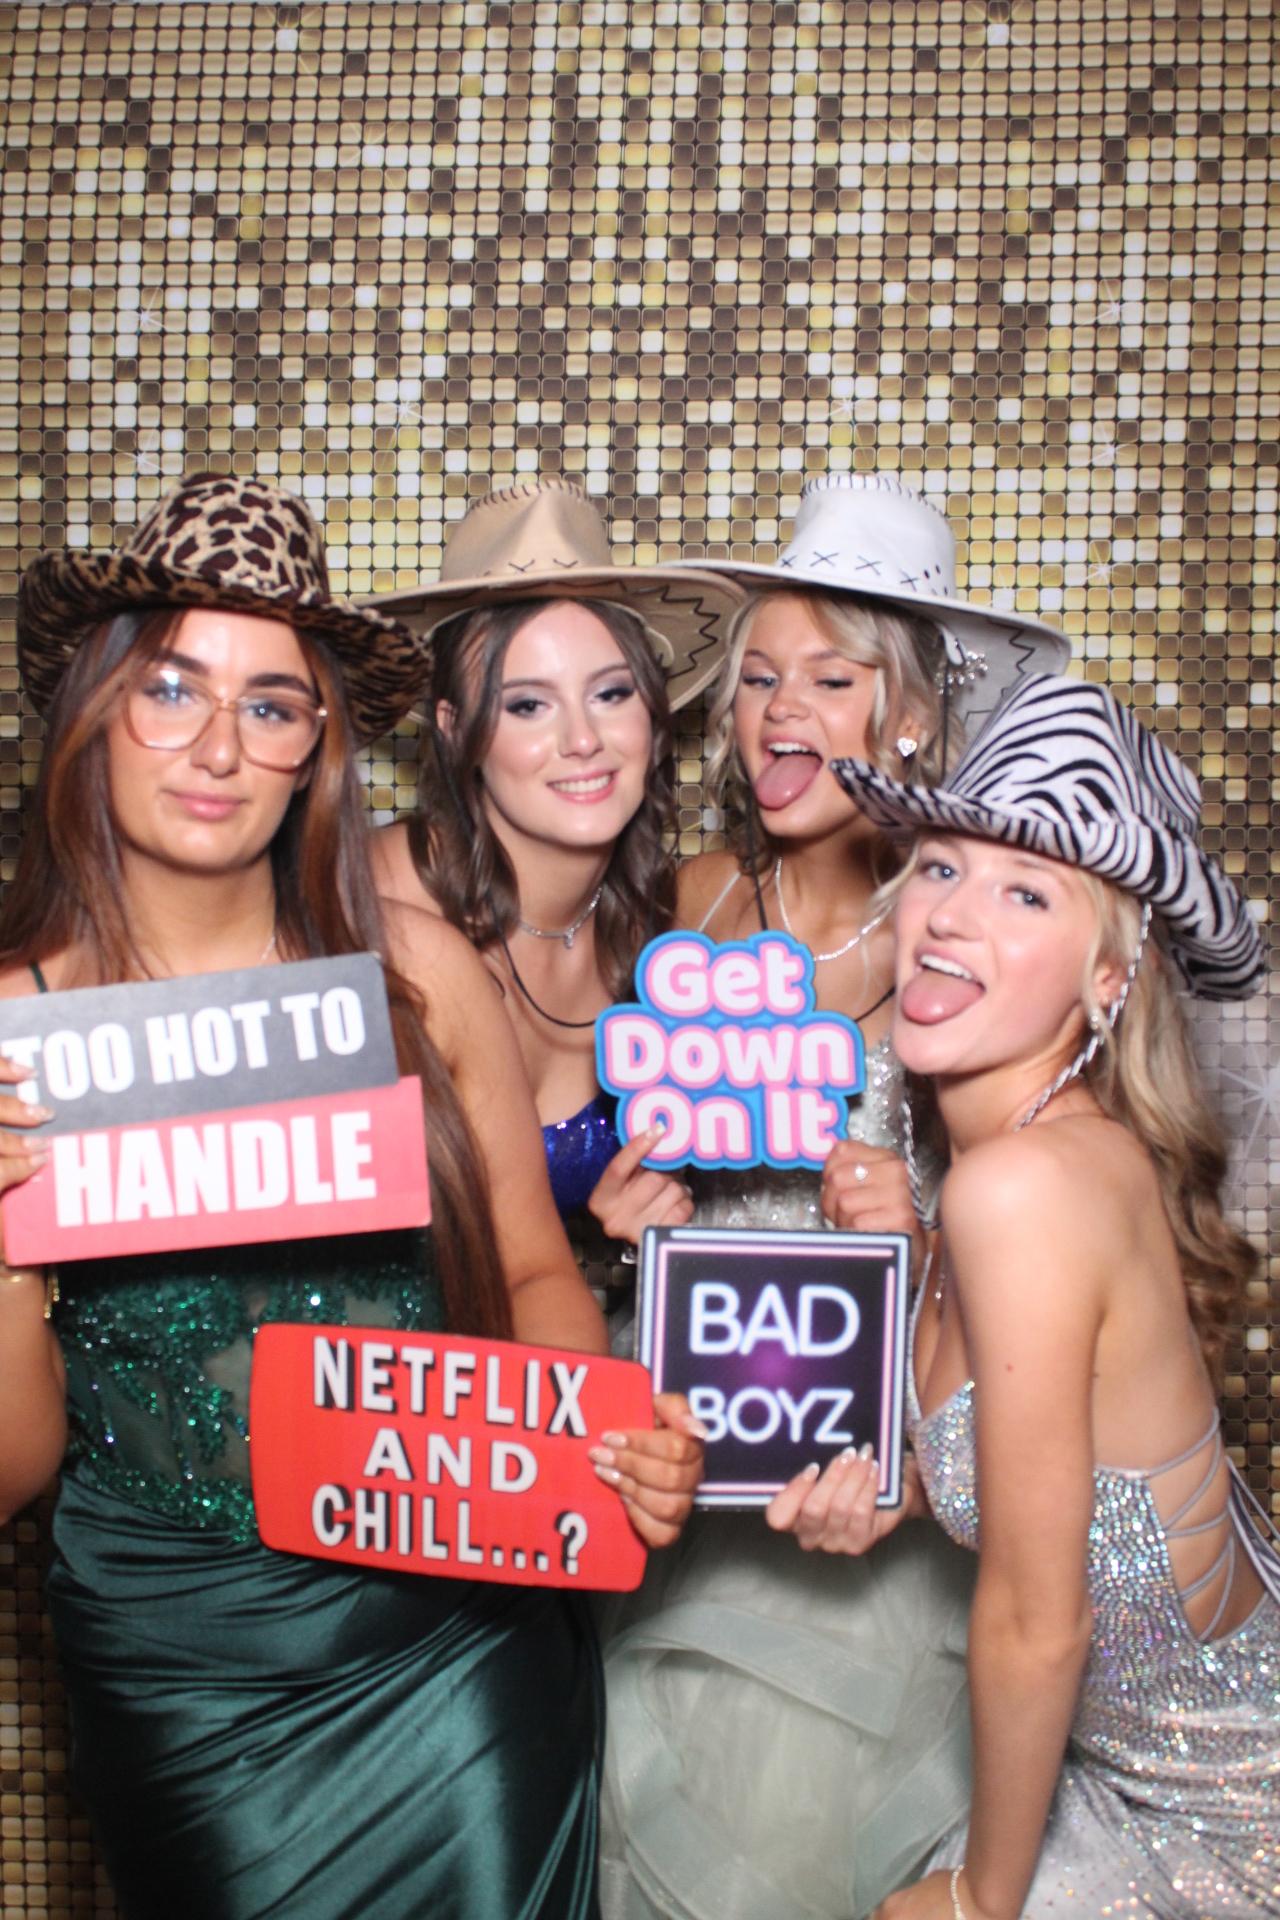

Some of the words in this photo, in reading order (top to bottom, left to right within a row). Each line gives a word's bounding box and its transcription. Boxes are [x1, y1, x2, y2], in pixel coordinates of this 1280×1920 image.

[647, 943, 804, 1014] Get
[1, 1022, 135, 1105] TOO
[145, 1001, 270, 1085] HOT
[280, 986, 366, 1061] TO
[607, 1017, 853, 1086] Down
[630, 1088, 752, 1156] On
[768, 1088, 838, 1156] It
[53, 1112, 376, 1227] HANDLE
[690, 1281, 861, 1357] BAD
[313, 1336, 589, 1437] NETFLIX
[688, 1386, 855, 1444] BOYZ
[363, 1428, 539, 1493] AND
[312, 1483, 589, 1576] CHILL...?
